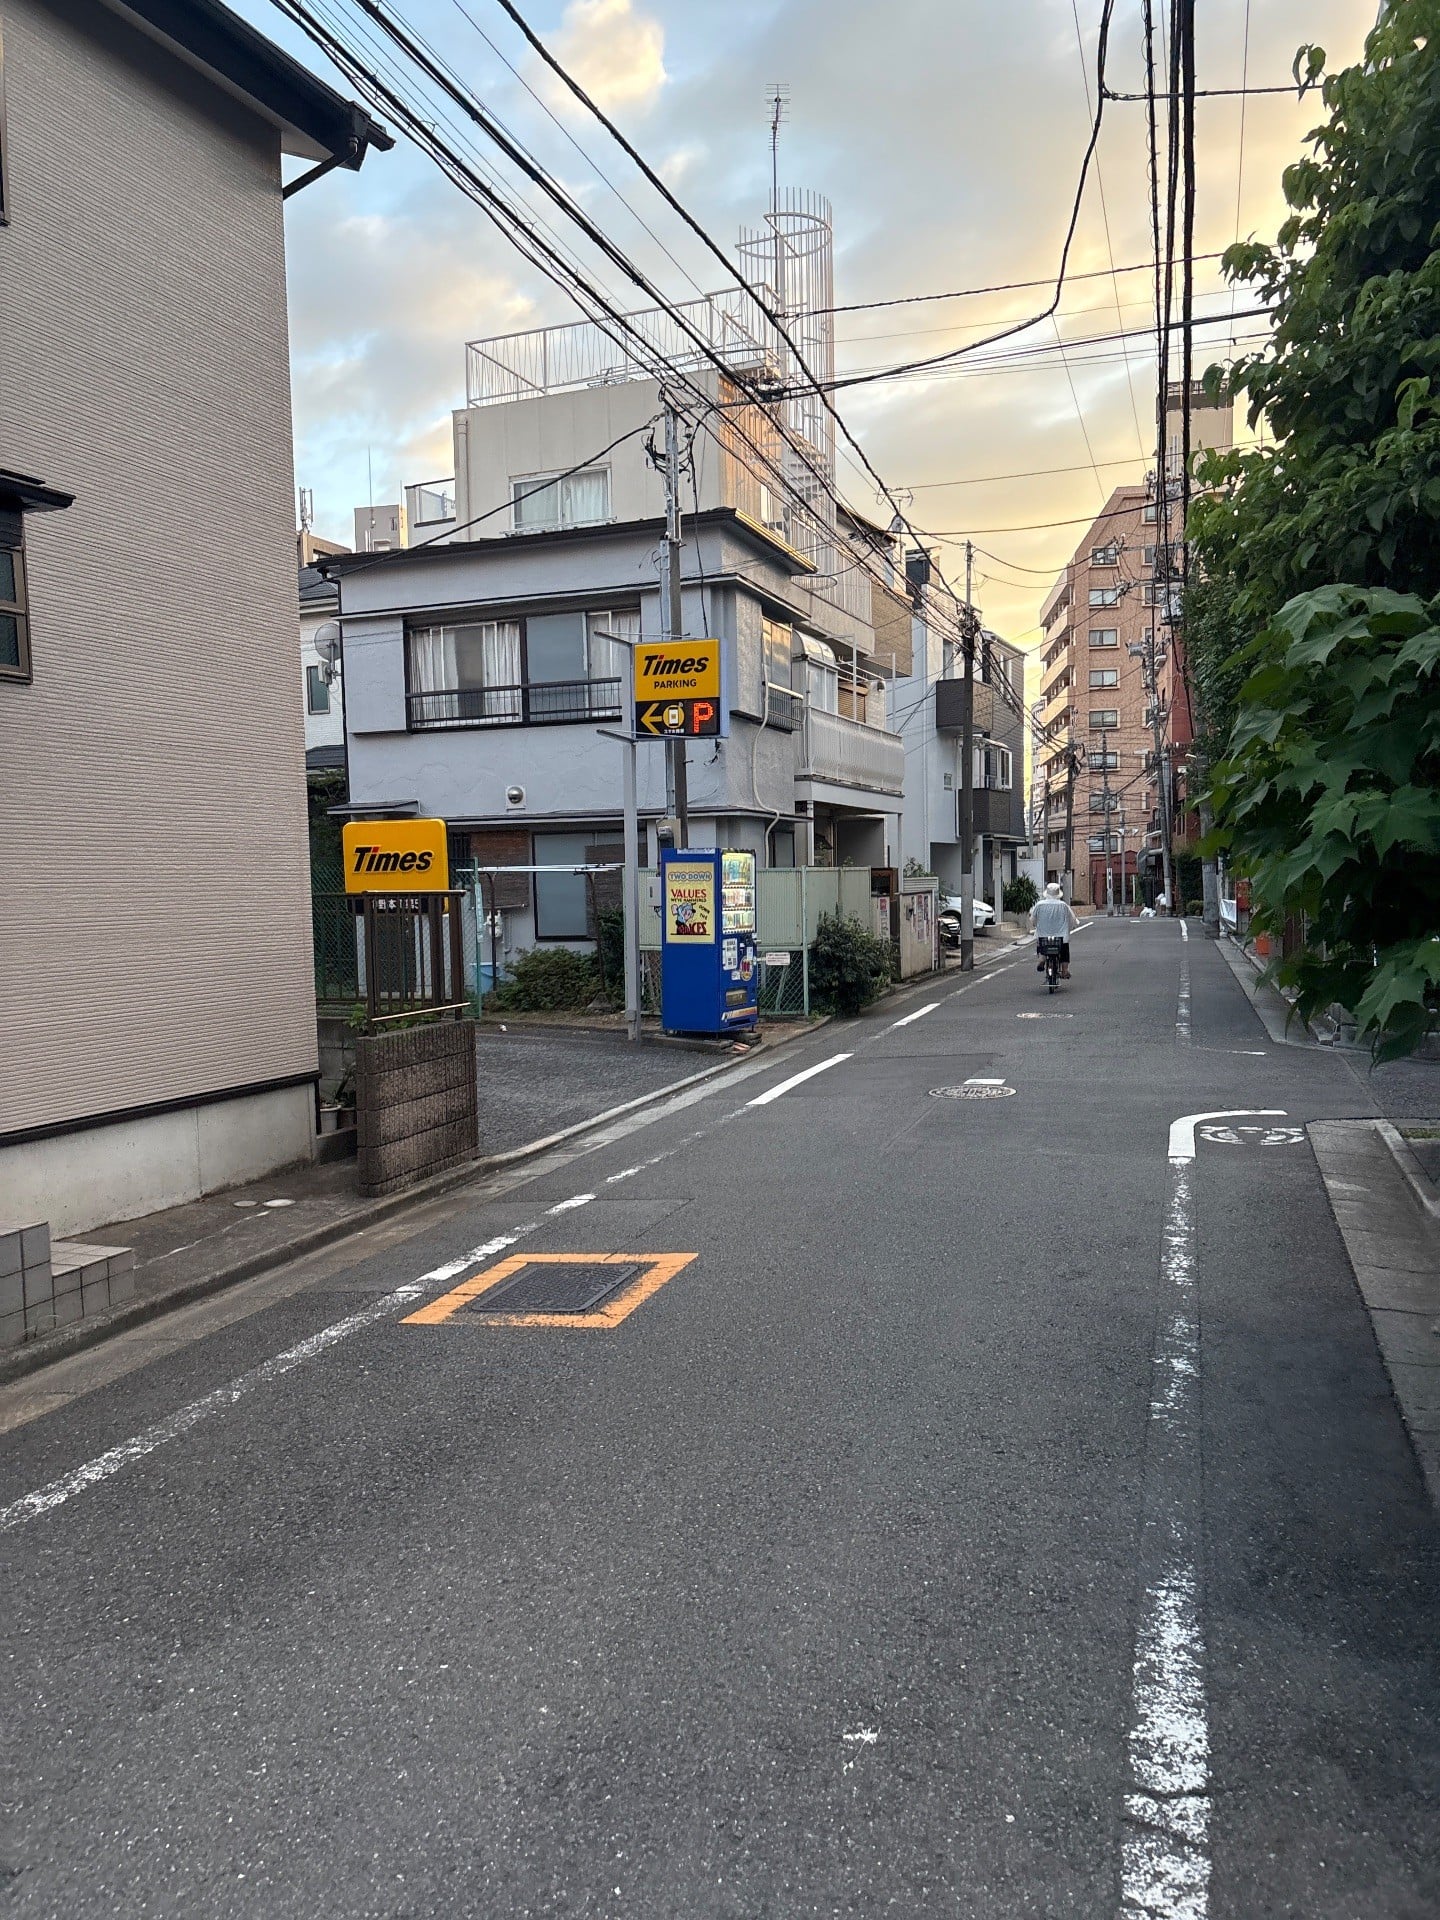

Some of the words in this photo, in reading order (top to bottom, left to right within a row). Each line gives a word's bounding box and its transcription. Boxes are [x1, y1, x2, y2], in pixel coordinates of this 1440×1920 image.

[643, 654, 709, 676] Times
[654, 679, 697, 689] PARKING
[693, 702, 714, 733] P
[353, 846, 434, 872] Times
[670, 872, 687, 880] TWO
[688, 872, 711, 880] DOWN
[671, 889, 707, 898] VALUES
